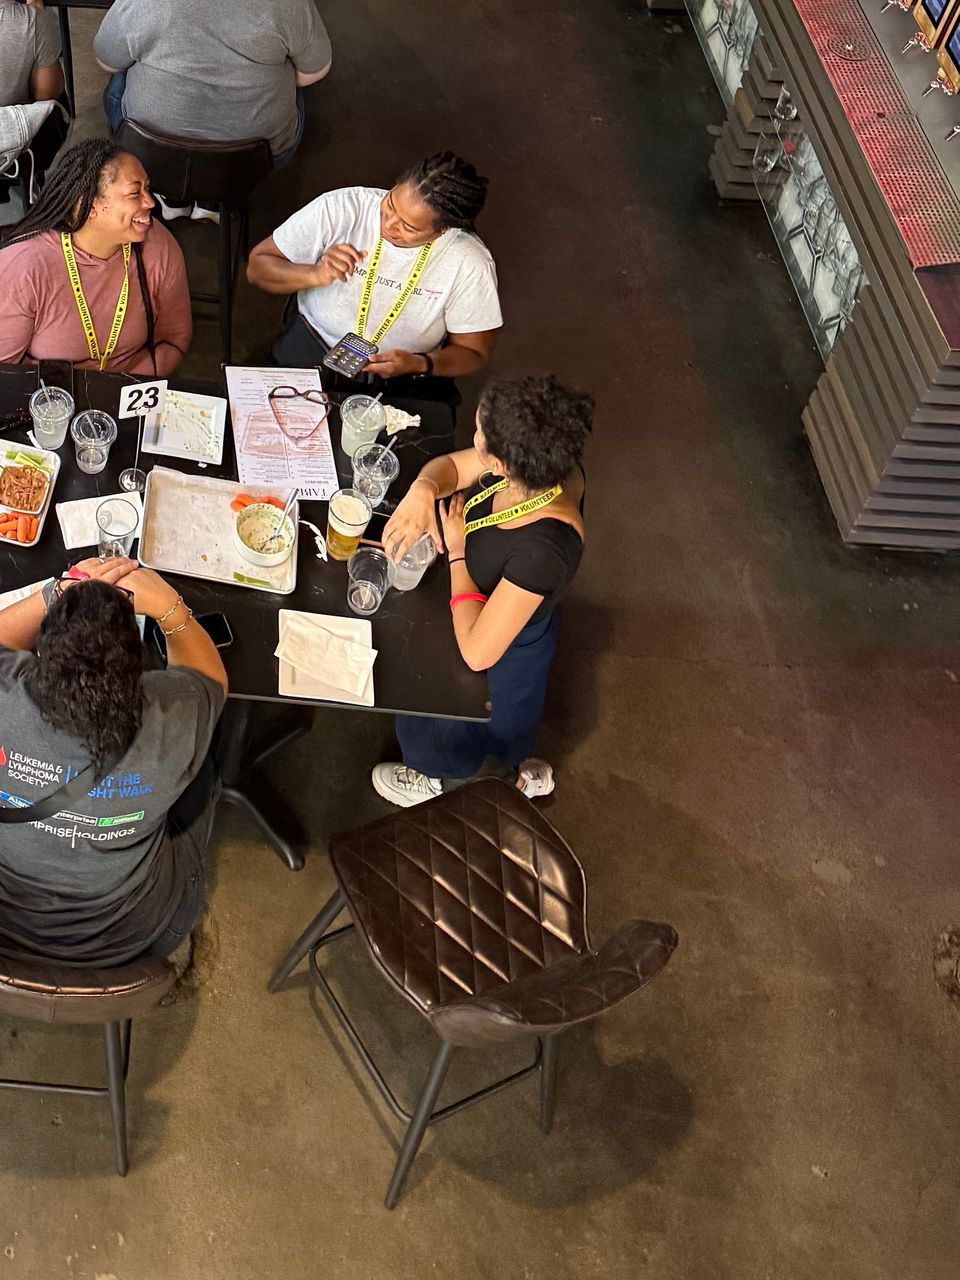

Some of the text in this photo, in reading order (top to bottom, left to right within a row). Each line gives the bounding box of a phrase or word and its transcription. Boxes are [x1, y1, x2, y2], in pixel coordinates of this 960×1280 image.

[65, 249, 79, 286] VOLUNTEER
[415, 241, 433, 272] VOLUNTE
[361, 268, 376, 305] VOLUNTEER
[375, 276, 396, 288] JUST
[395, 283, 402, 291] A
[392, 279, 416, 313] VOLUNTEER
[77, 293, 92, 331] VOLUNTEER
[108, 314, 122, 350] VOLUNTEER
[373, 318, 392, 345] LUNTEER
[127, 386, 160, 412] 23
[520, 490, 555, 513] VOLUNTEER
[485, 510, 514, 524] VOLUNTEER
[8, 760, 60, 783] LYMPHOMA
[9, 751, 63, 774] LEUKEMIA &
[7, 769, 49, 788] SOCIETY
[8, 796, 32, 808] Alam
[88, 787, 117, 799] GHT
[56, 811, 96, 825] nterprise
